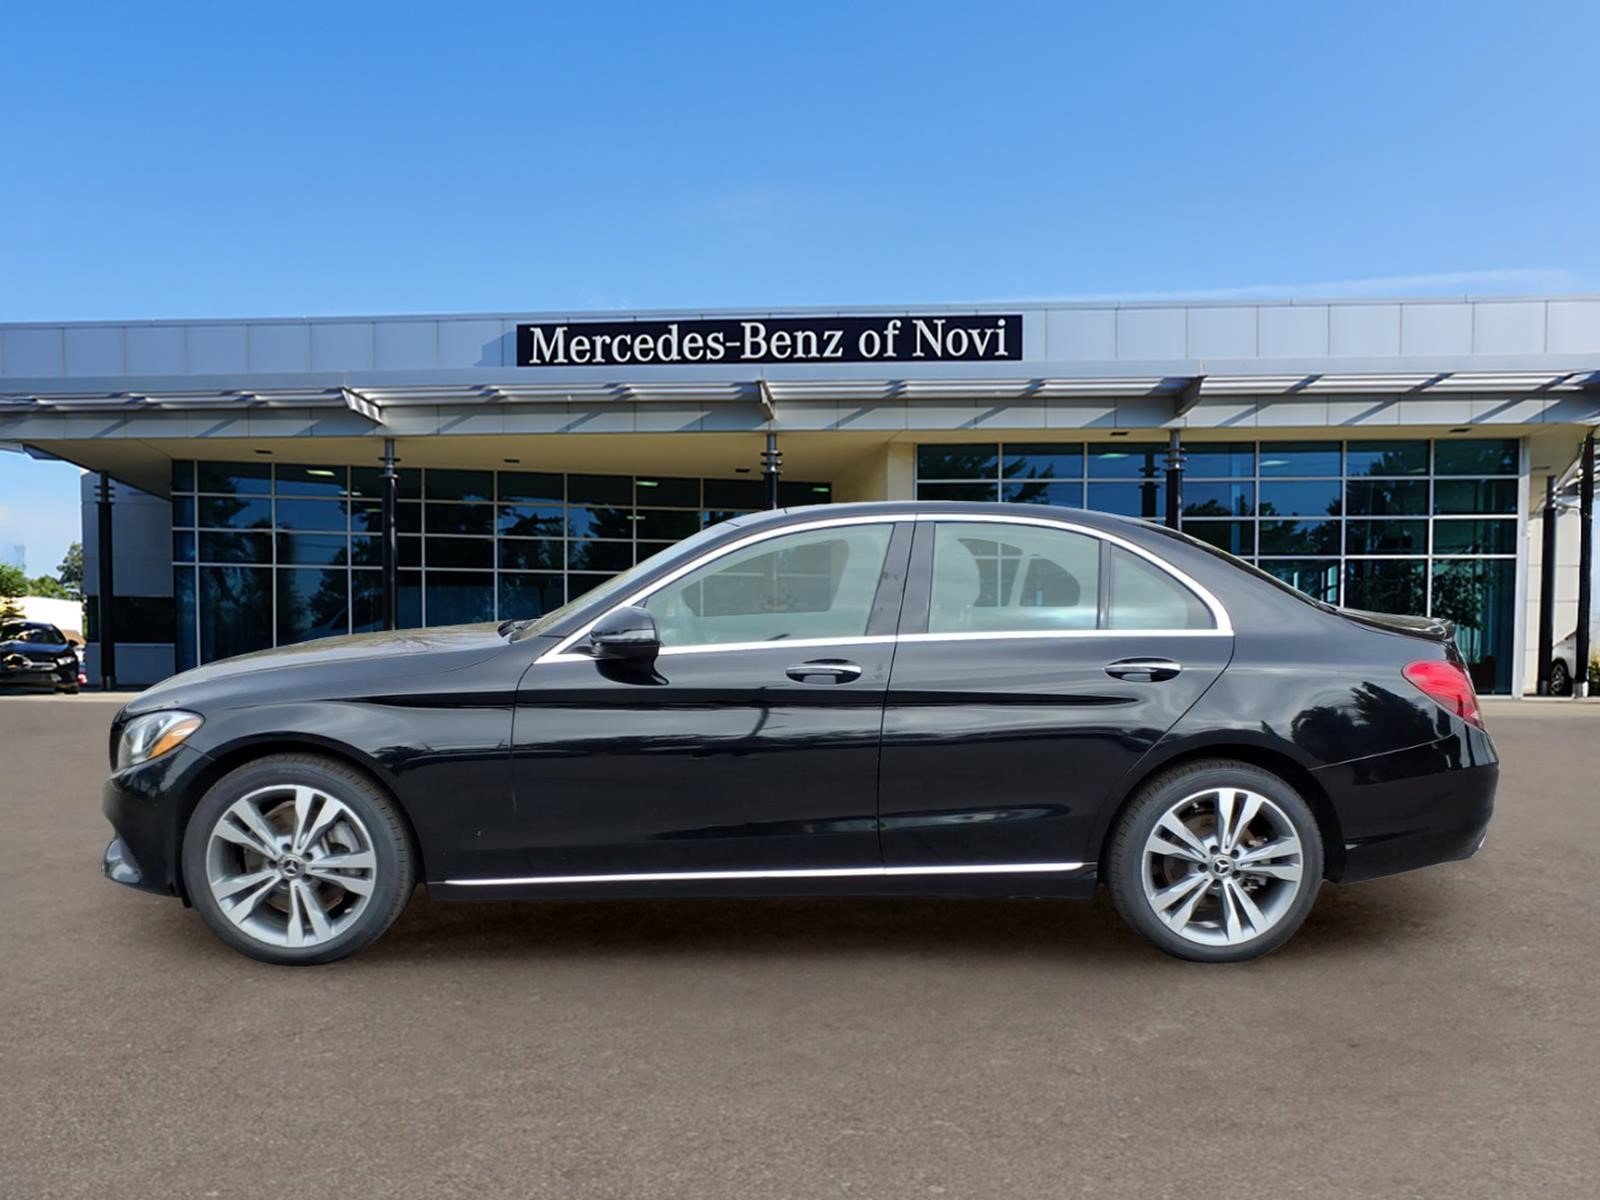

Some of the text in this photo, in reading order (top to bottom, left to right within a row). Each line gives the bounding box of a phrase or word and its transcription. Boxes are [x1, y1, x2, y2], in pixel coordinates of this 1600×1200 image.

[529, 318, 1009, 364] Mercedes-Benz of Novi
